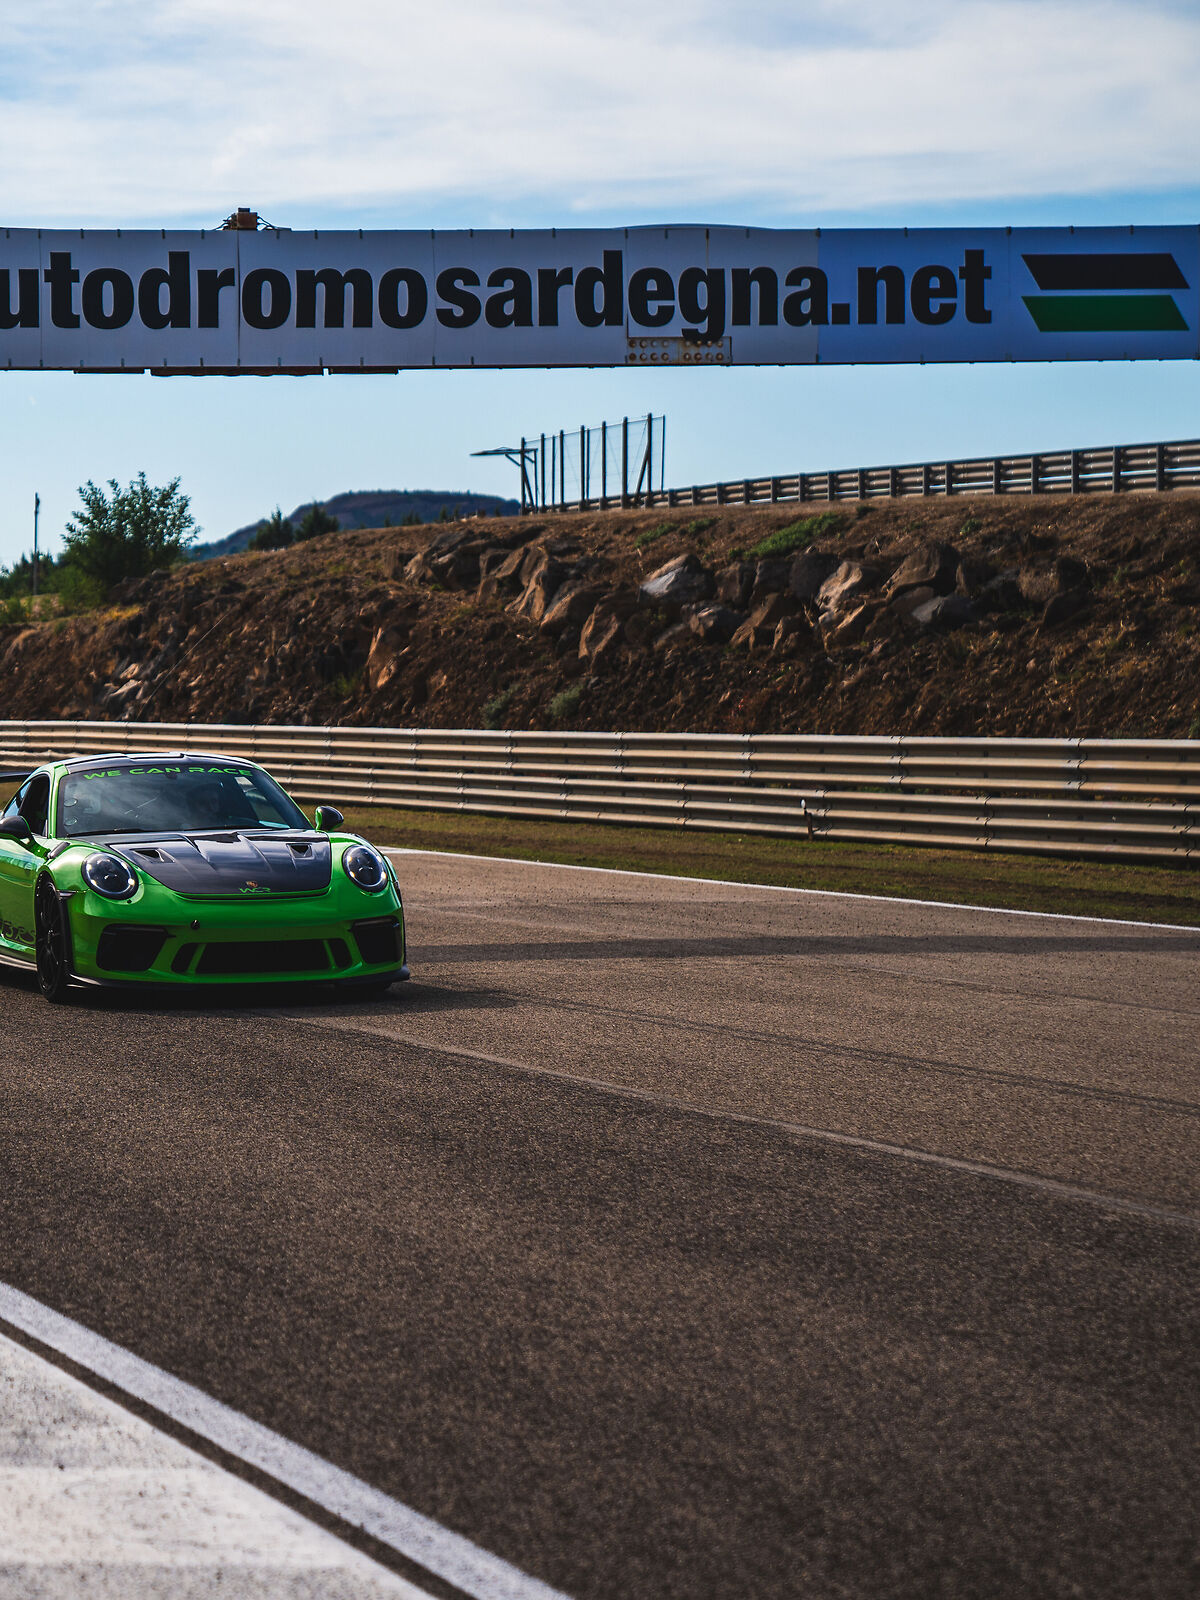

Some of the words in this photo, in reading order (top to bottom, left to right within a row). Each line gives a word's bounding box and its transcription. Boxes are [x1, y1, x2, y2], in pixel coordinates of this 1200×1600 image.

[83, 771, 121, 780] WE
[129, 767, 181, 775] CAN
[188, 767, 253, 777] RACE
